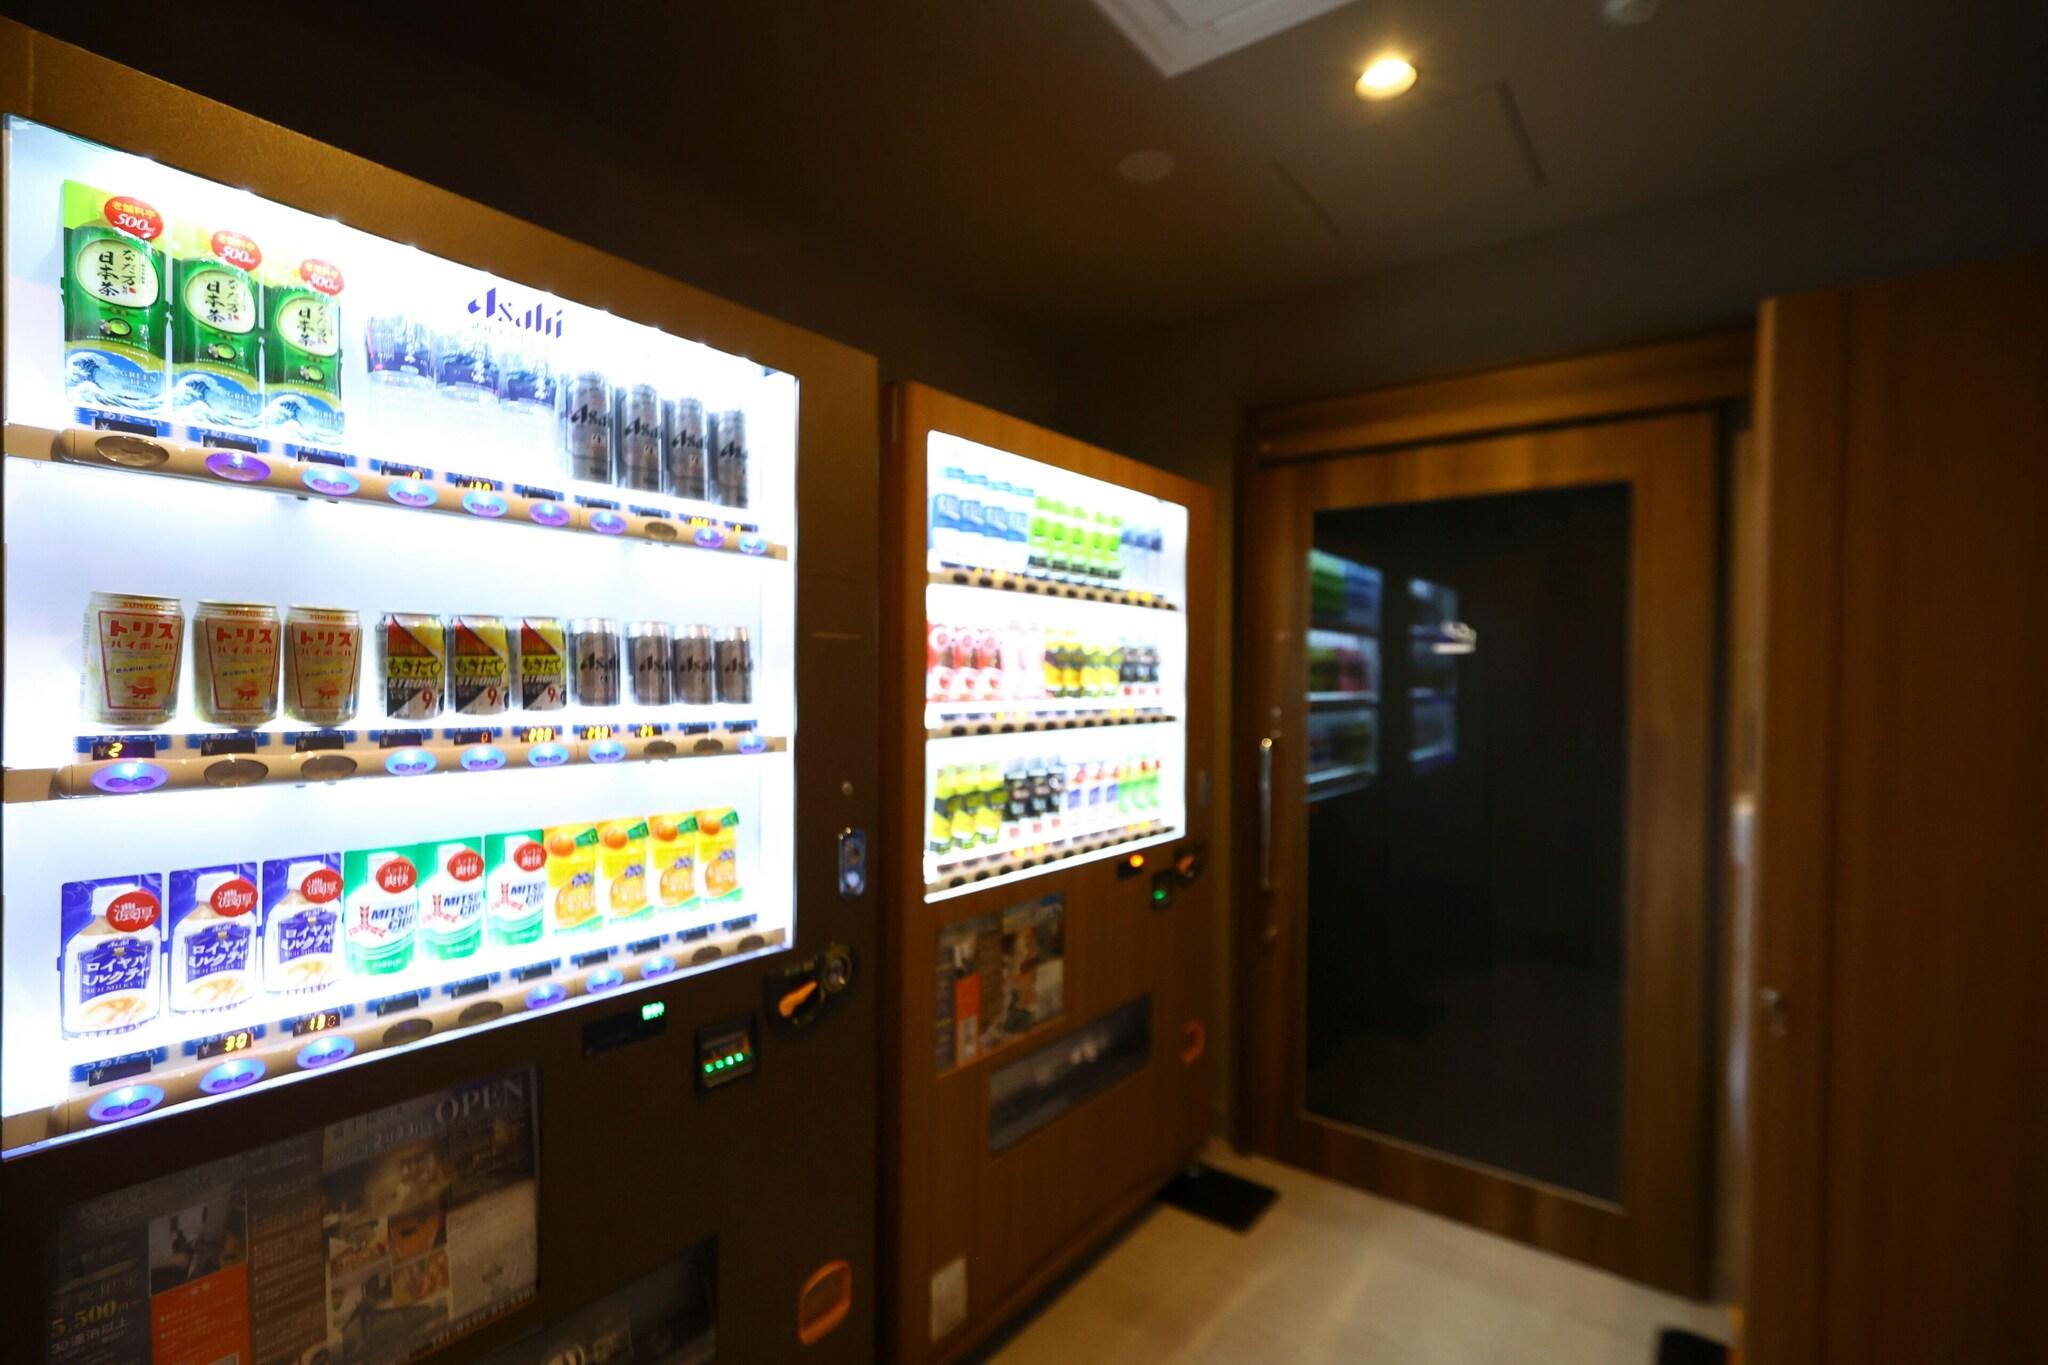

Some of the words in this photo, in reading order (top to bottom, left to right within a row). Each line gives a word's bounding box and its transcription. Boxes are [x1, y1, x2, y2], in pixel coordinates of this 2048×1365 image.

[97, 251, 120, 296] 日本茶
[205, 280, 225, 322] 日本茶
[467, 286, 562, 338] Asahi
[571, 404, 612, 428] Asa
[624, 417, 661, 438] Asa
[671, 429, 706, 448] Asa
[110, 620, 174, 639] トリス
[216, 627, 273, 644] トリス
[300, 630, 352, 647] トリス
[422, 688, 433, 709] 9
[487, 687, 498, 706] 9
[547, 686, 556, 703] 9
[286, 924, 334, 938] ロイヤル
[193, 938, 247, 955] ロイヤル
[281, 935, 334, 950] ミルクティ
[87, 954, 148, 972] ロイヤル
[189, 949, 249, 967] ミルクティ
[81, 967, 150, 986] ミルクティ
[434, 1075, 525, 1123] OPEN
